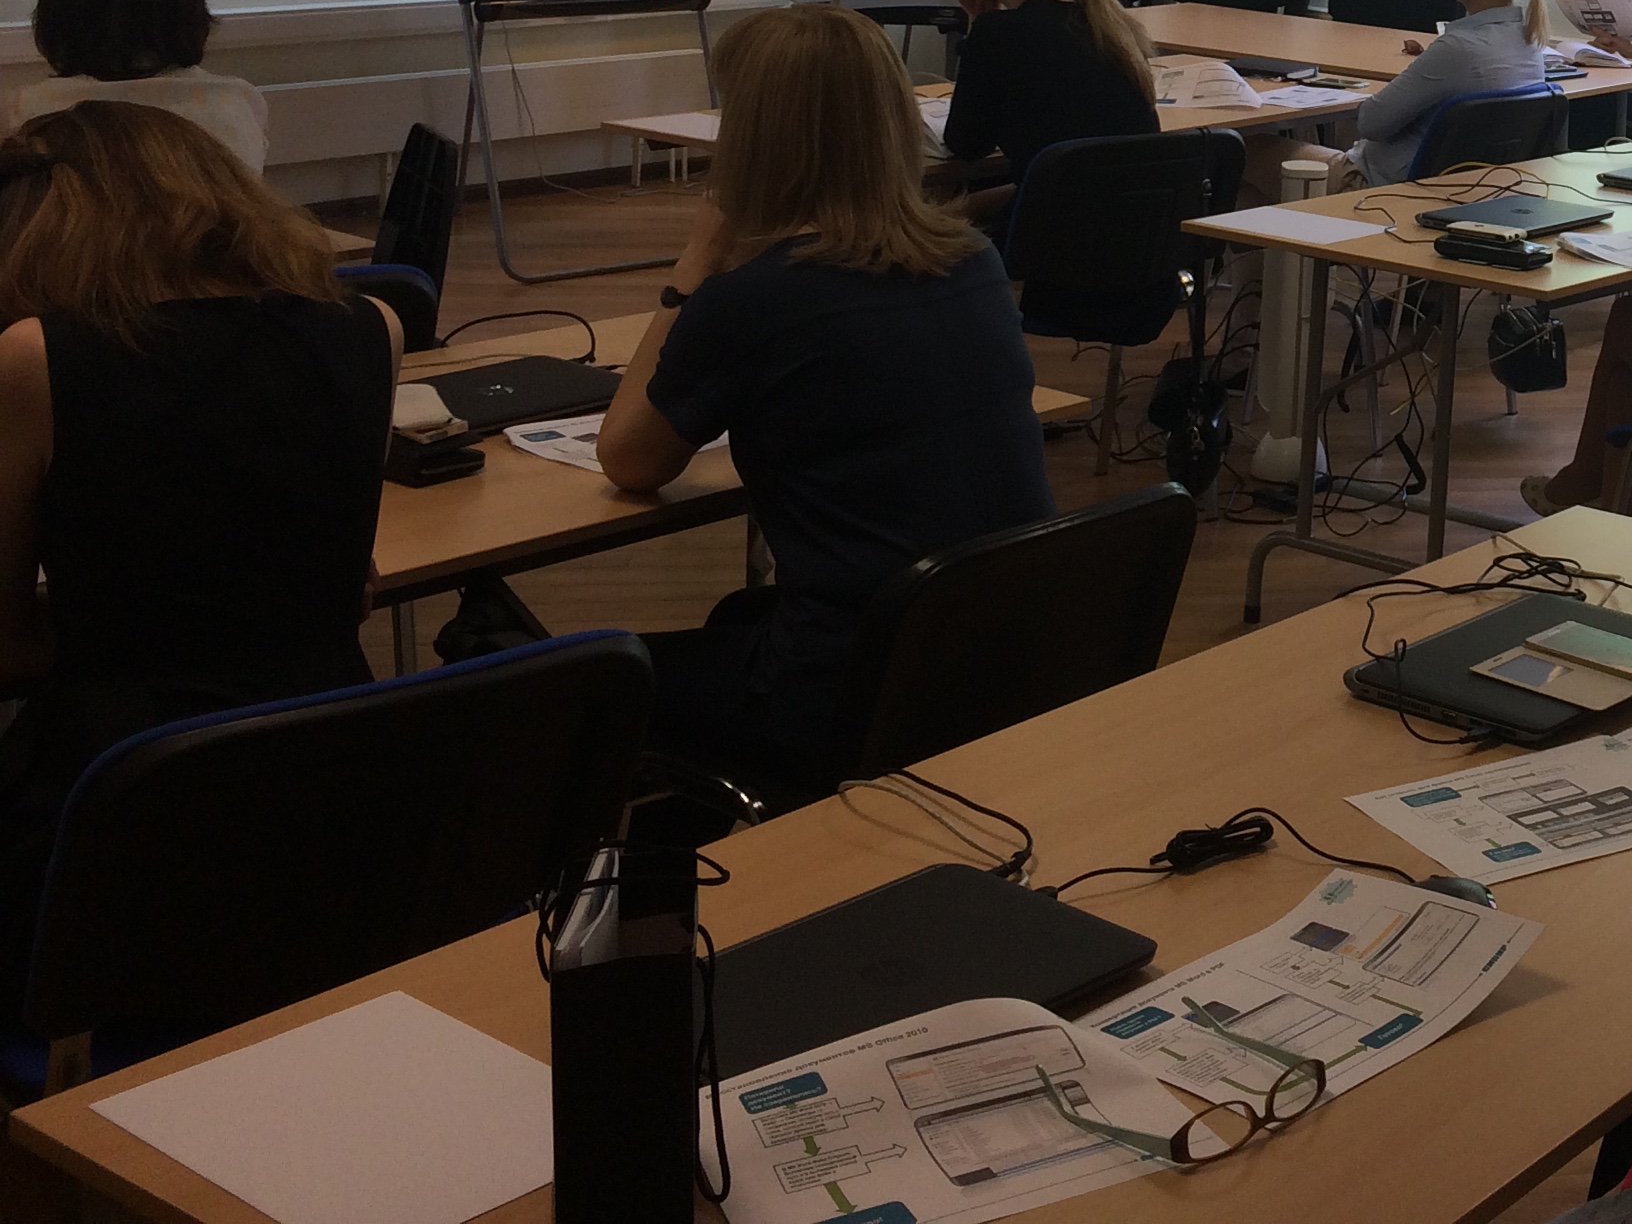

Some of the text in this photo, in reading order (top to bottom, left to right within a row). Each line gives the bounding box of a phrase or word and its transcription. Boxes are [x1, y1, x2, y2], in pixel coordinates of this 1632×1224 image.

[857, 1042, 874, 1054] MS
[875, 1033, 905, 1048] Office
[905, 1026, 929, 1038] 2010
